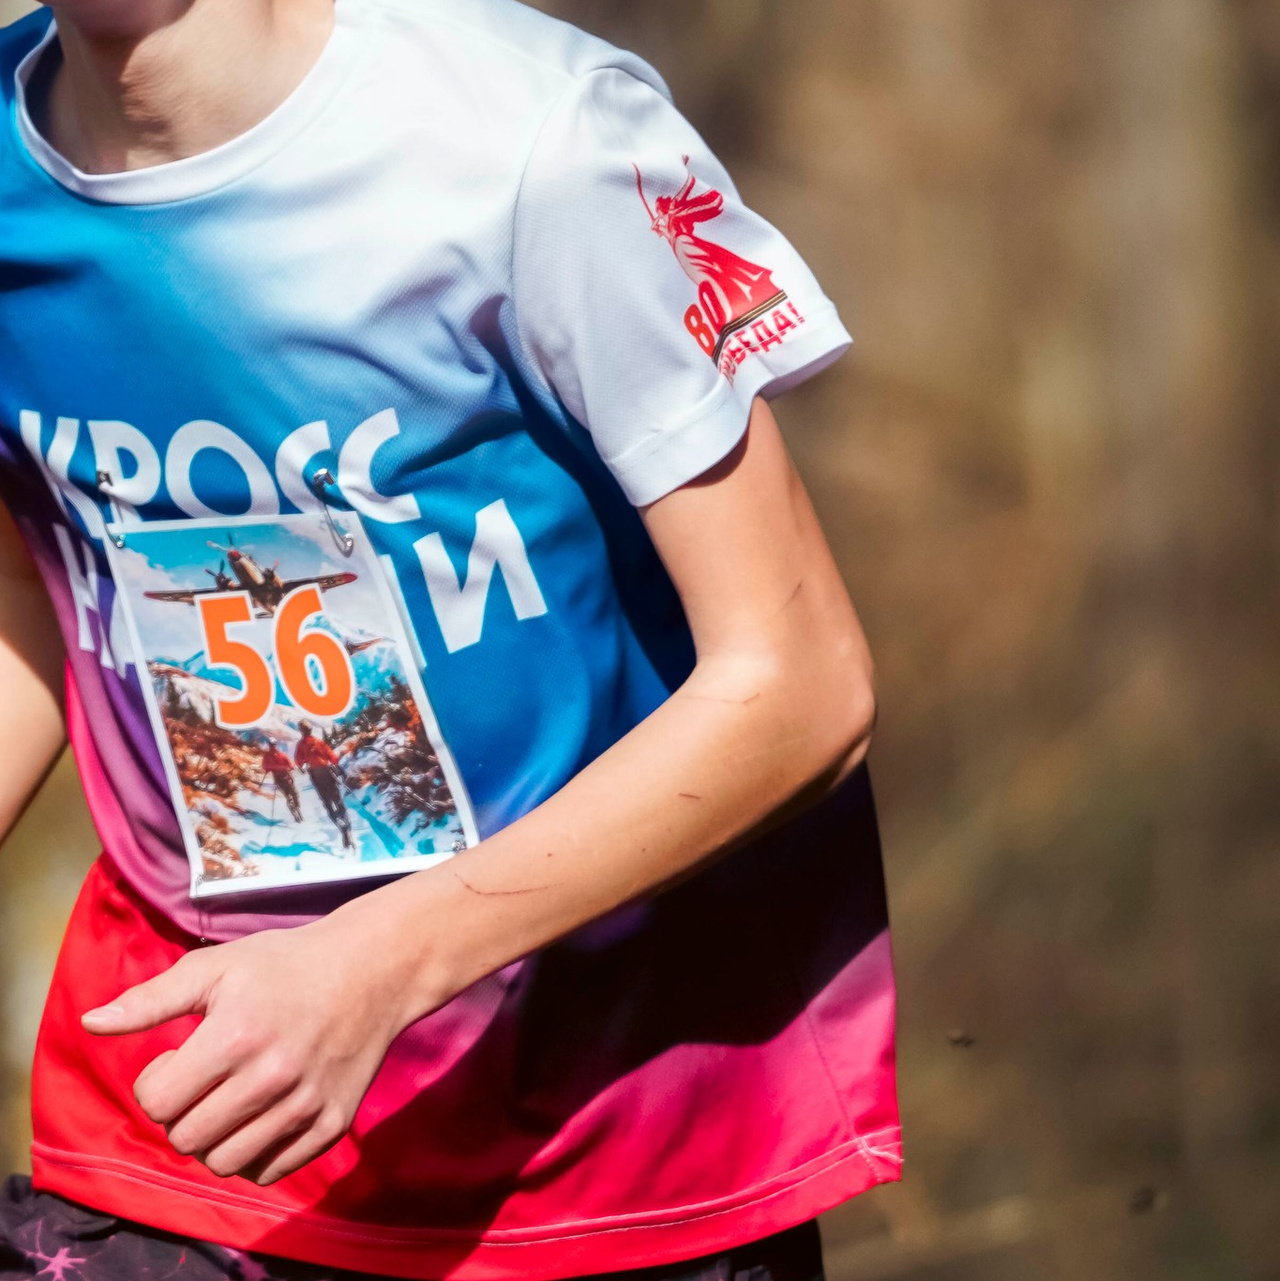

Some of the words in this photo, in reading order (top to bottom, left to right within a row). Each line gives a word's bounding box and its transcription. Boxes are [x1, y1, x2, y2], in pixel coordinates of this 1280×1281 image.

[684, 280, 727, 360] 80
[20, 406, 421, 539] КРОСС
[196, 584, 355, 730] 56
